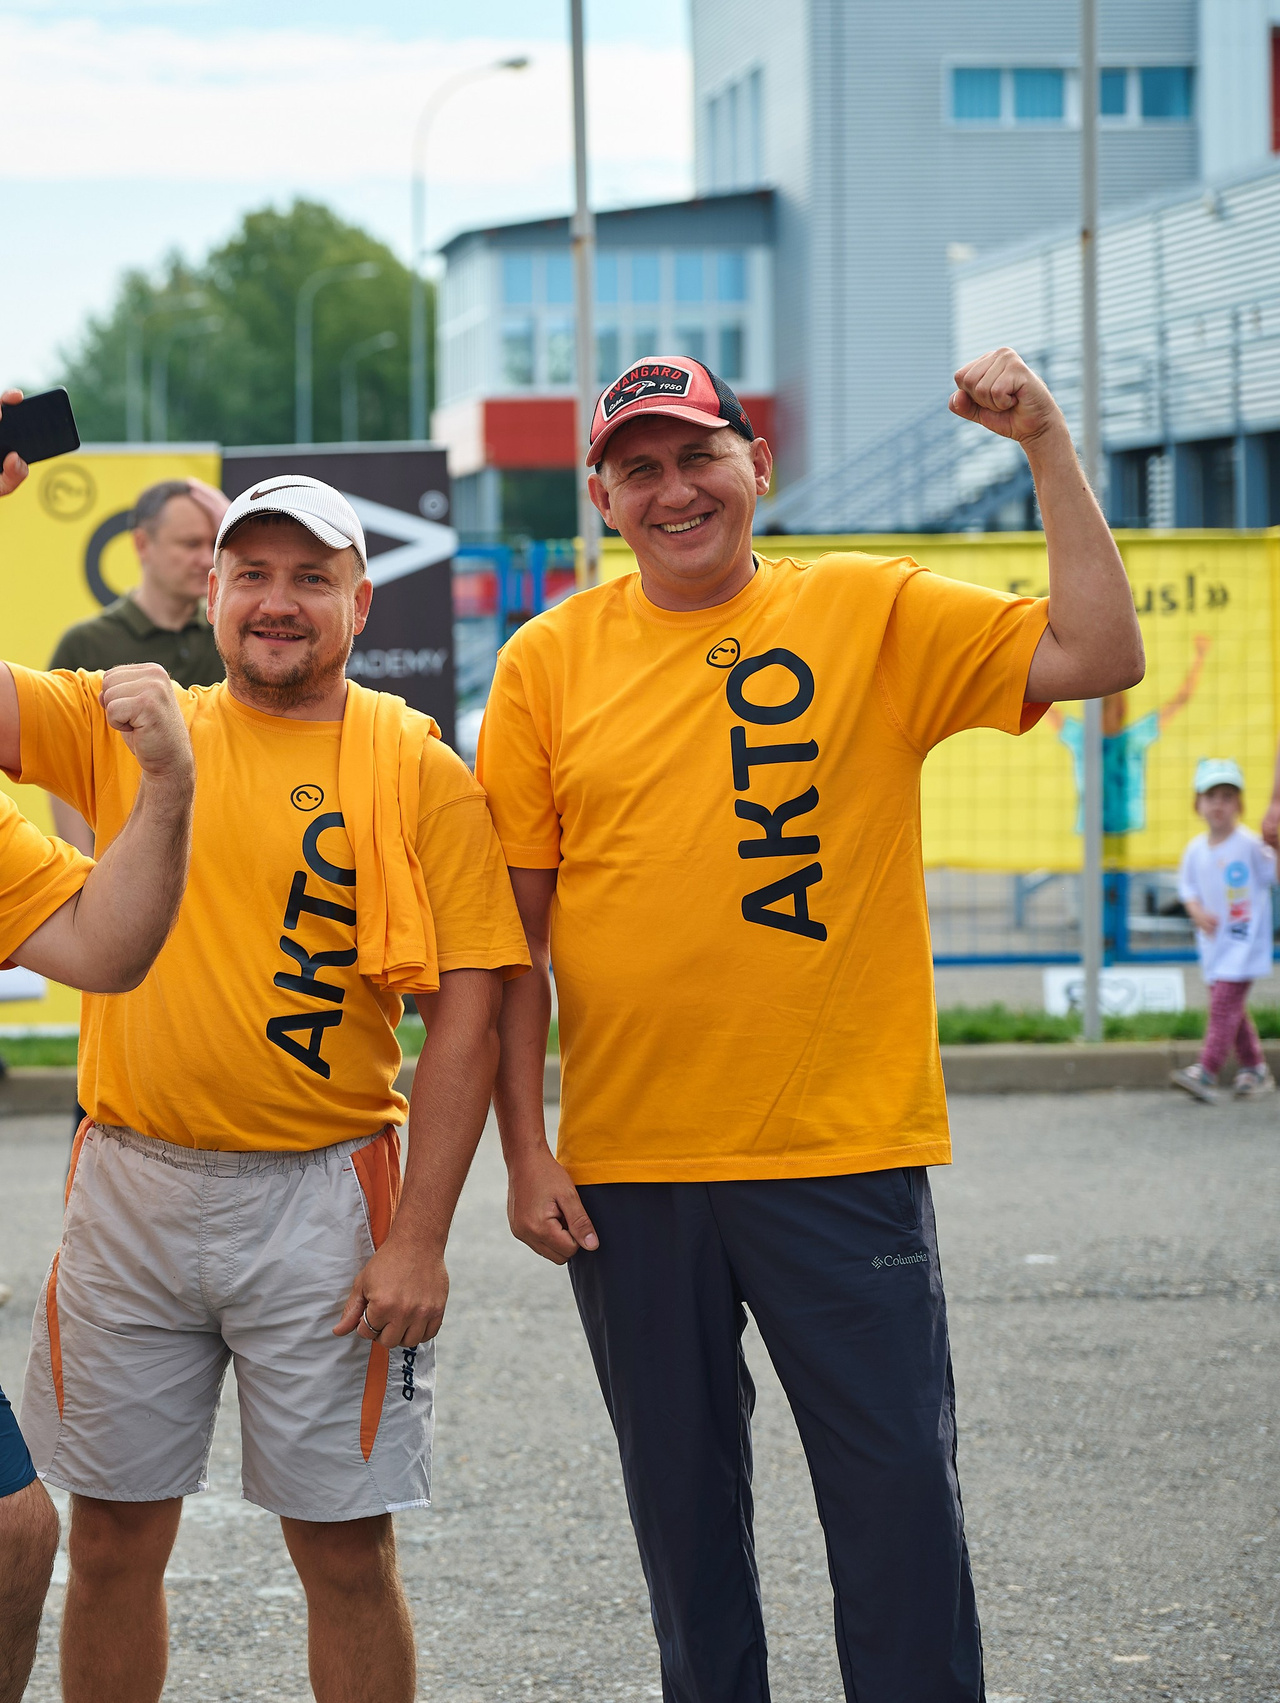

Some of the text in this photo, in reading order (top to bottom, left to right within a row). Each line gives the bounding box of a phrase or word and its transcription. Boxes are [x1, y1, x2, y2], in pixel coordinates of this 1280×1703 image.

[608, 365, 682, 400] AVANGARD
[659, 382, 682, 391] 1950
[346, 648, 449, 679] ADEMY
[884, 1250, 928, 1267] Columbia
[401, 1345, 418, 1402] adid
